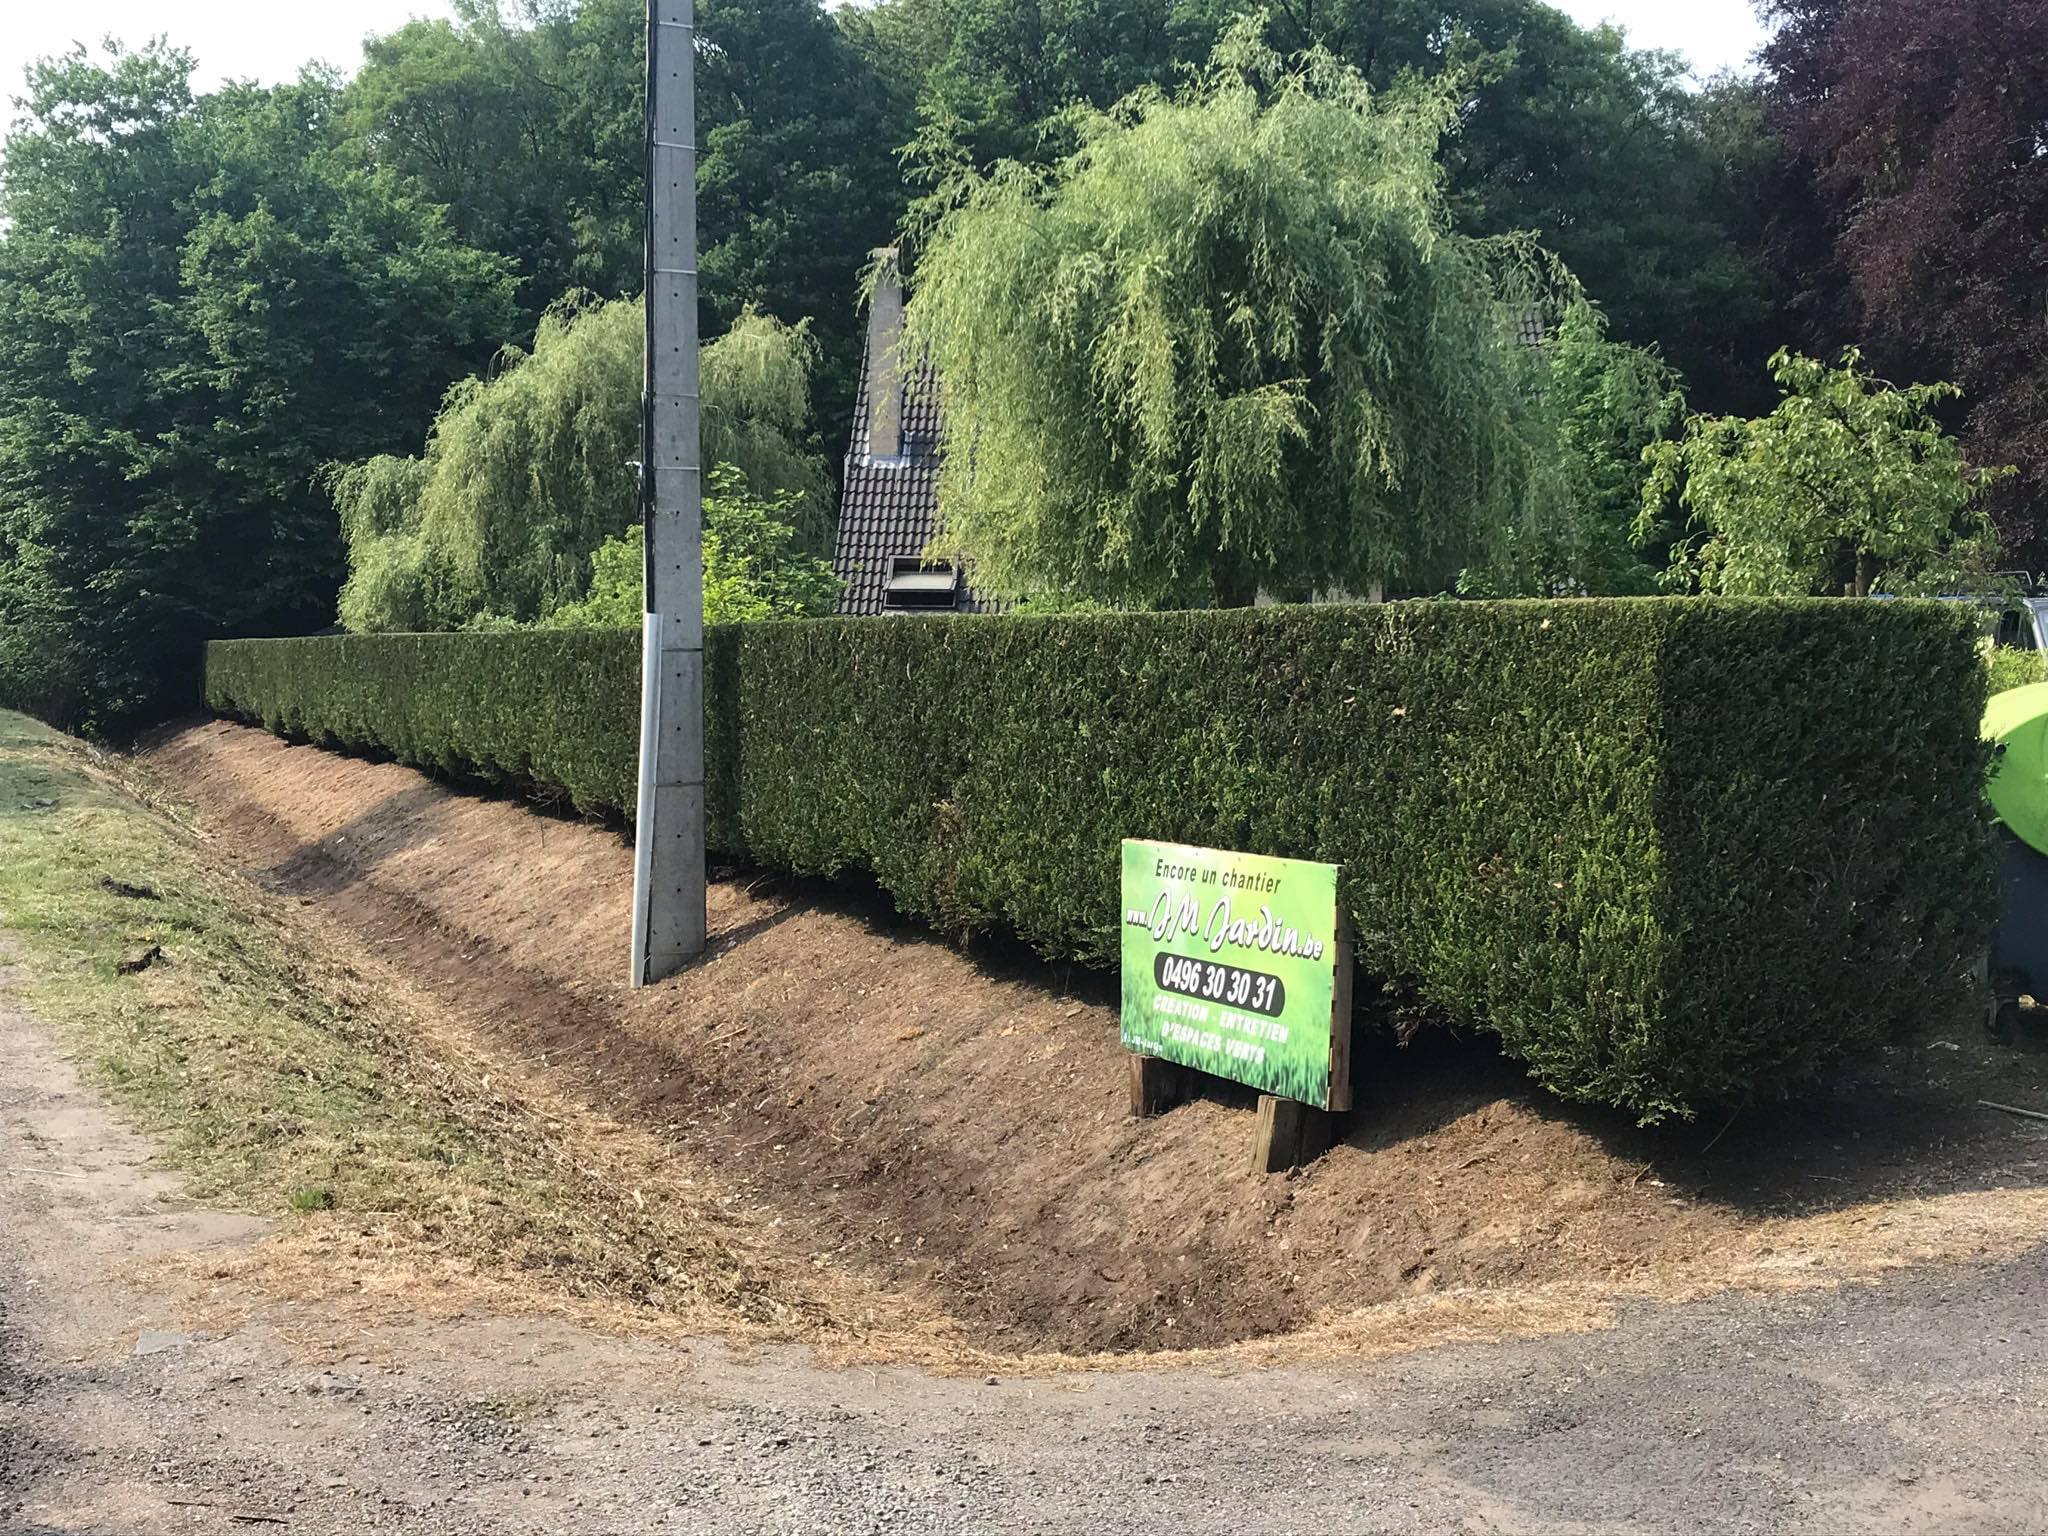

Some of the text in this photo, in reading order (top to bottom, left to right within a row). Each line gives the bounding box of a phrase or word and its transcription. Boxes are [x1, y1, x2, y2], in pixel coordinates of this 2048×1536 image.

[1155, 858, 1281, 894] Encore un chantier
[1162, 956, 1276, 1011] 0496 30 30 31
[1219, 1010, 1289, 1044] ENTRETIEN
[1225, 1040, 1266, 1066] VERTS
